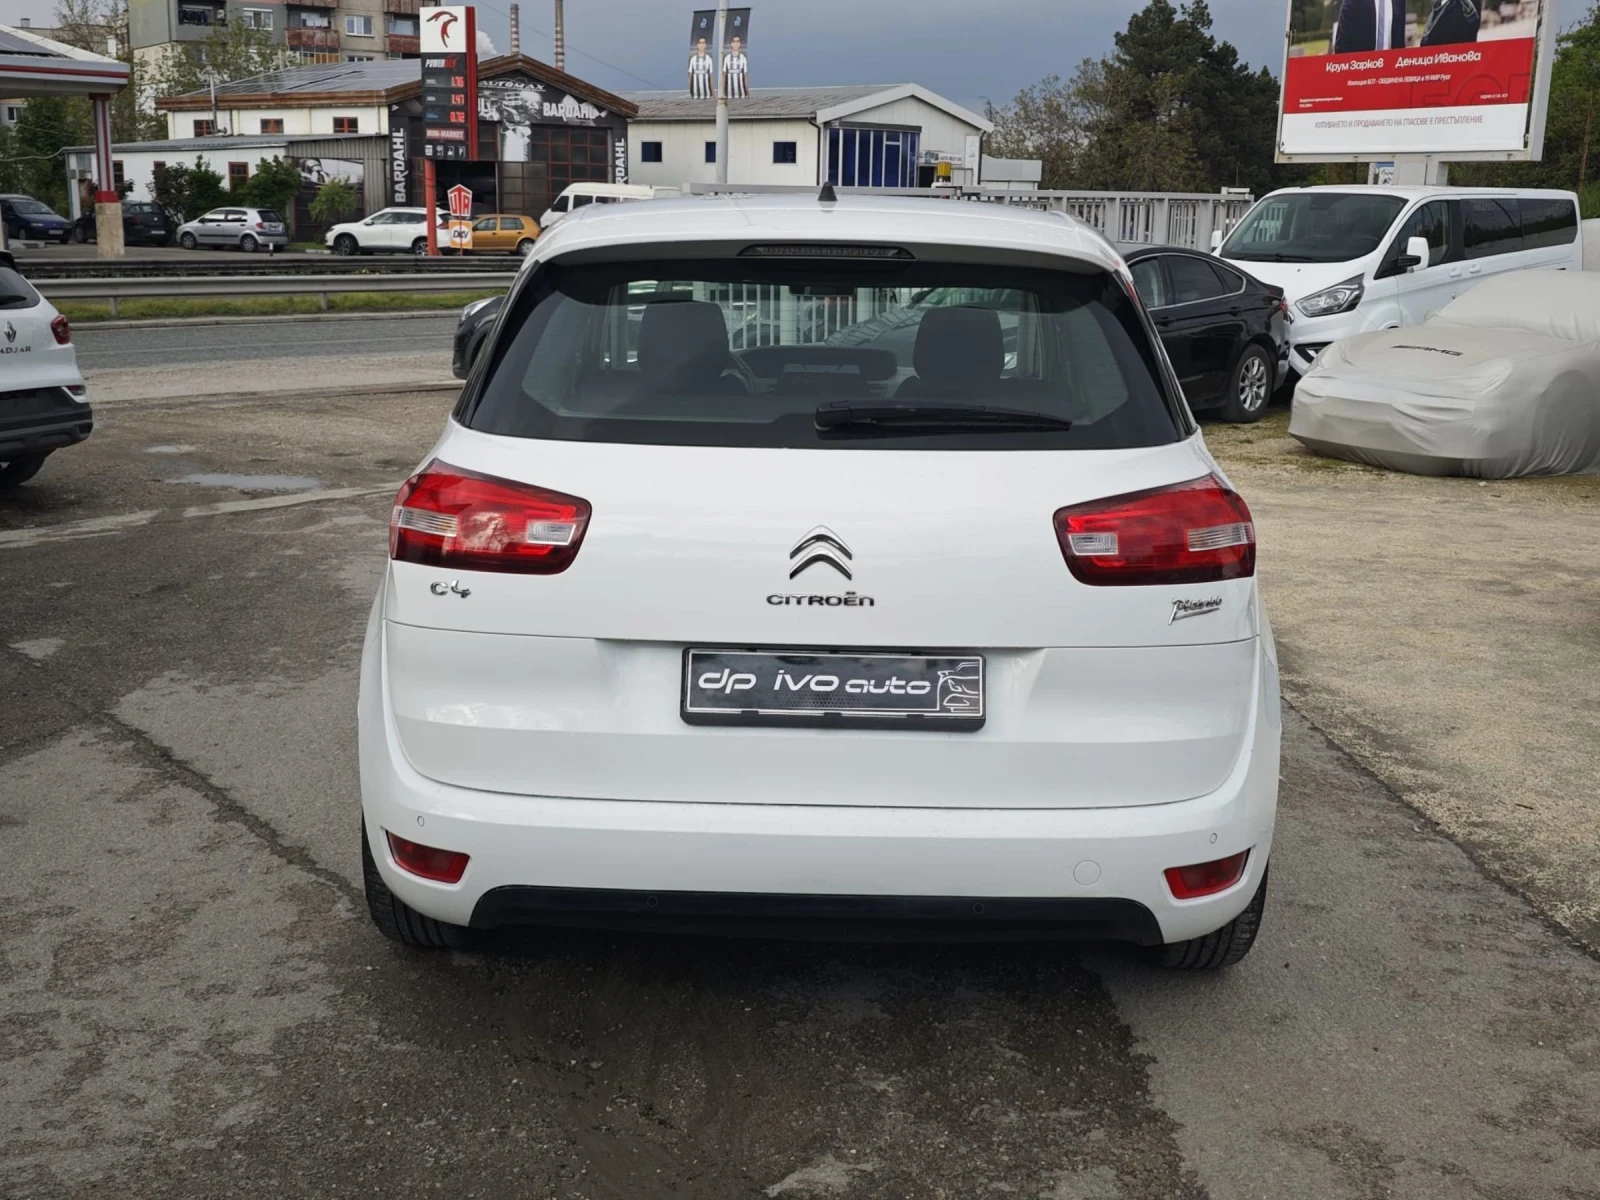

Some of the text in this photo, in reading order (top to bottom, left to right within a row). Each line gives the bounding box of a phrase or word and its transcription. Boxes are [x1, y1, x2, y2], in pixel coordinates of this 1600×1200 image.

[1326, 58, 1384, 73] Крум Зарков
[1395, 50, 1482, 68] Деница Иванова
[478, 80, 545, 92] AUTOMAX
[543, 103, 600, 121] BARDAHL
[1434, 115, 1484, 125] ПРЕСТЪПЛЕНИЕ
[392, 128, 408, 203] BARDAHL
[615, 138, 628, 185] RDAHL
[0, 346, 31, 354] ADJAR
[430, 579, 471, 598] C4
[766, 591, 875, 607] CITROËN
[698, 668, 931, 694] dp ivo auto
